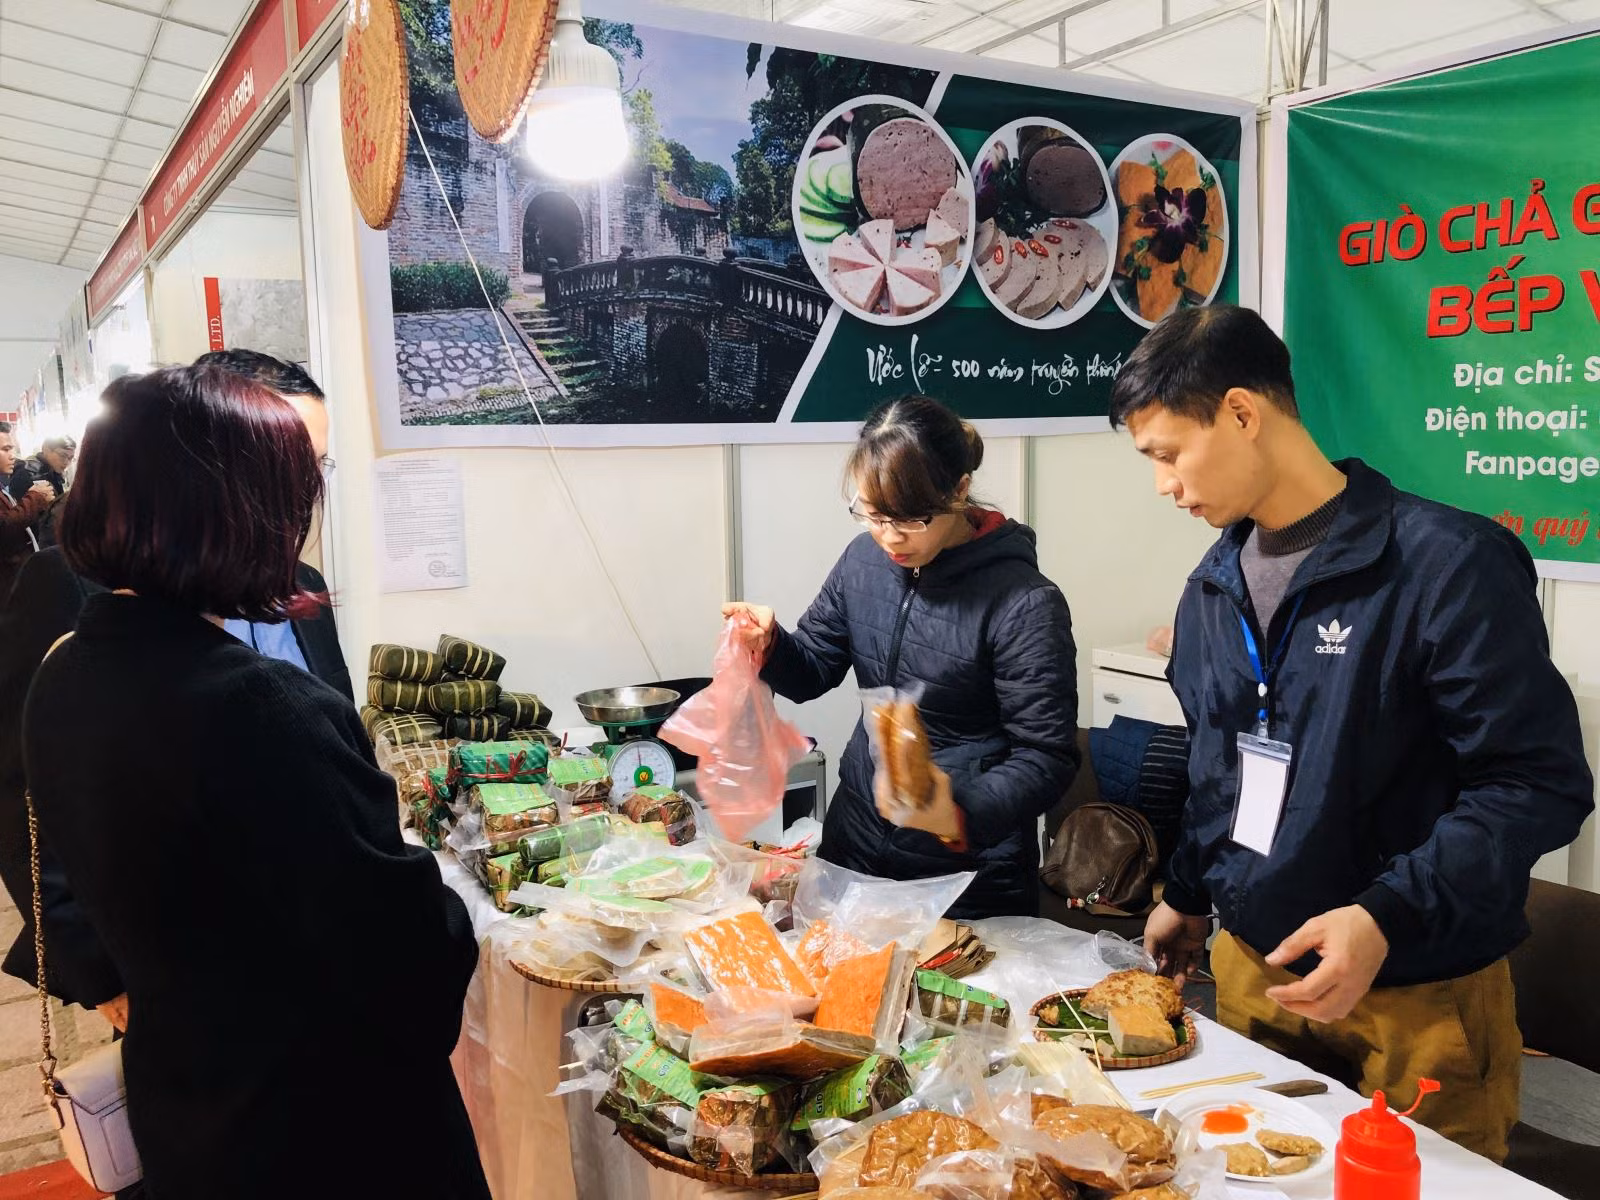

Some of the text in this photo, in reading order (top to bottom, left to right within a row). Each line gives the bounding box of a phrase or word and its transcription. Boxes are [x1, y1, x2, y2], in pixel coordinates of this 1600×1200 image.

[229, 67, 254, 123] NGHIÊM
[1338, 204, 1428, 267] GIÒ
[1438, 178, 1561, 254] CHẢ
[1427, 255, 1565, 338] BẾP
[211, 316, 222, 343] LTD.
[951, 359, 980, 378] 500
[1030, 353, 1079, 396] truyền
[1454, 363, 1504, 394] Địa
[1515, 354, 1573, 385] chỉ:
[1425, 405, 1487, 437] Điện
[1495, 404, 1588, 437] thoại:
[1533, 508, 1591, 546] quý
[1315, 643, 1346, 655] adidas
